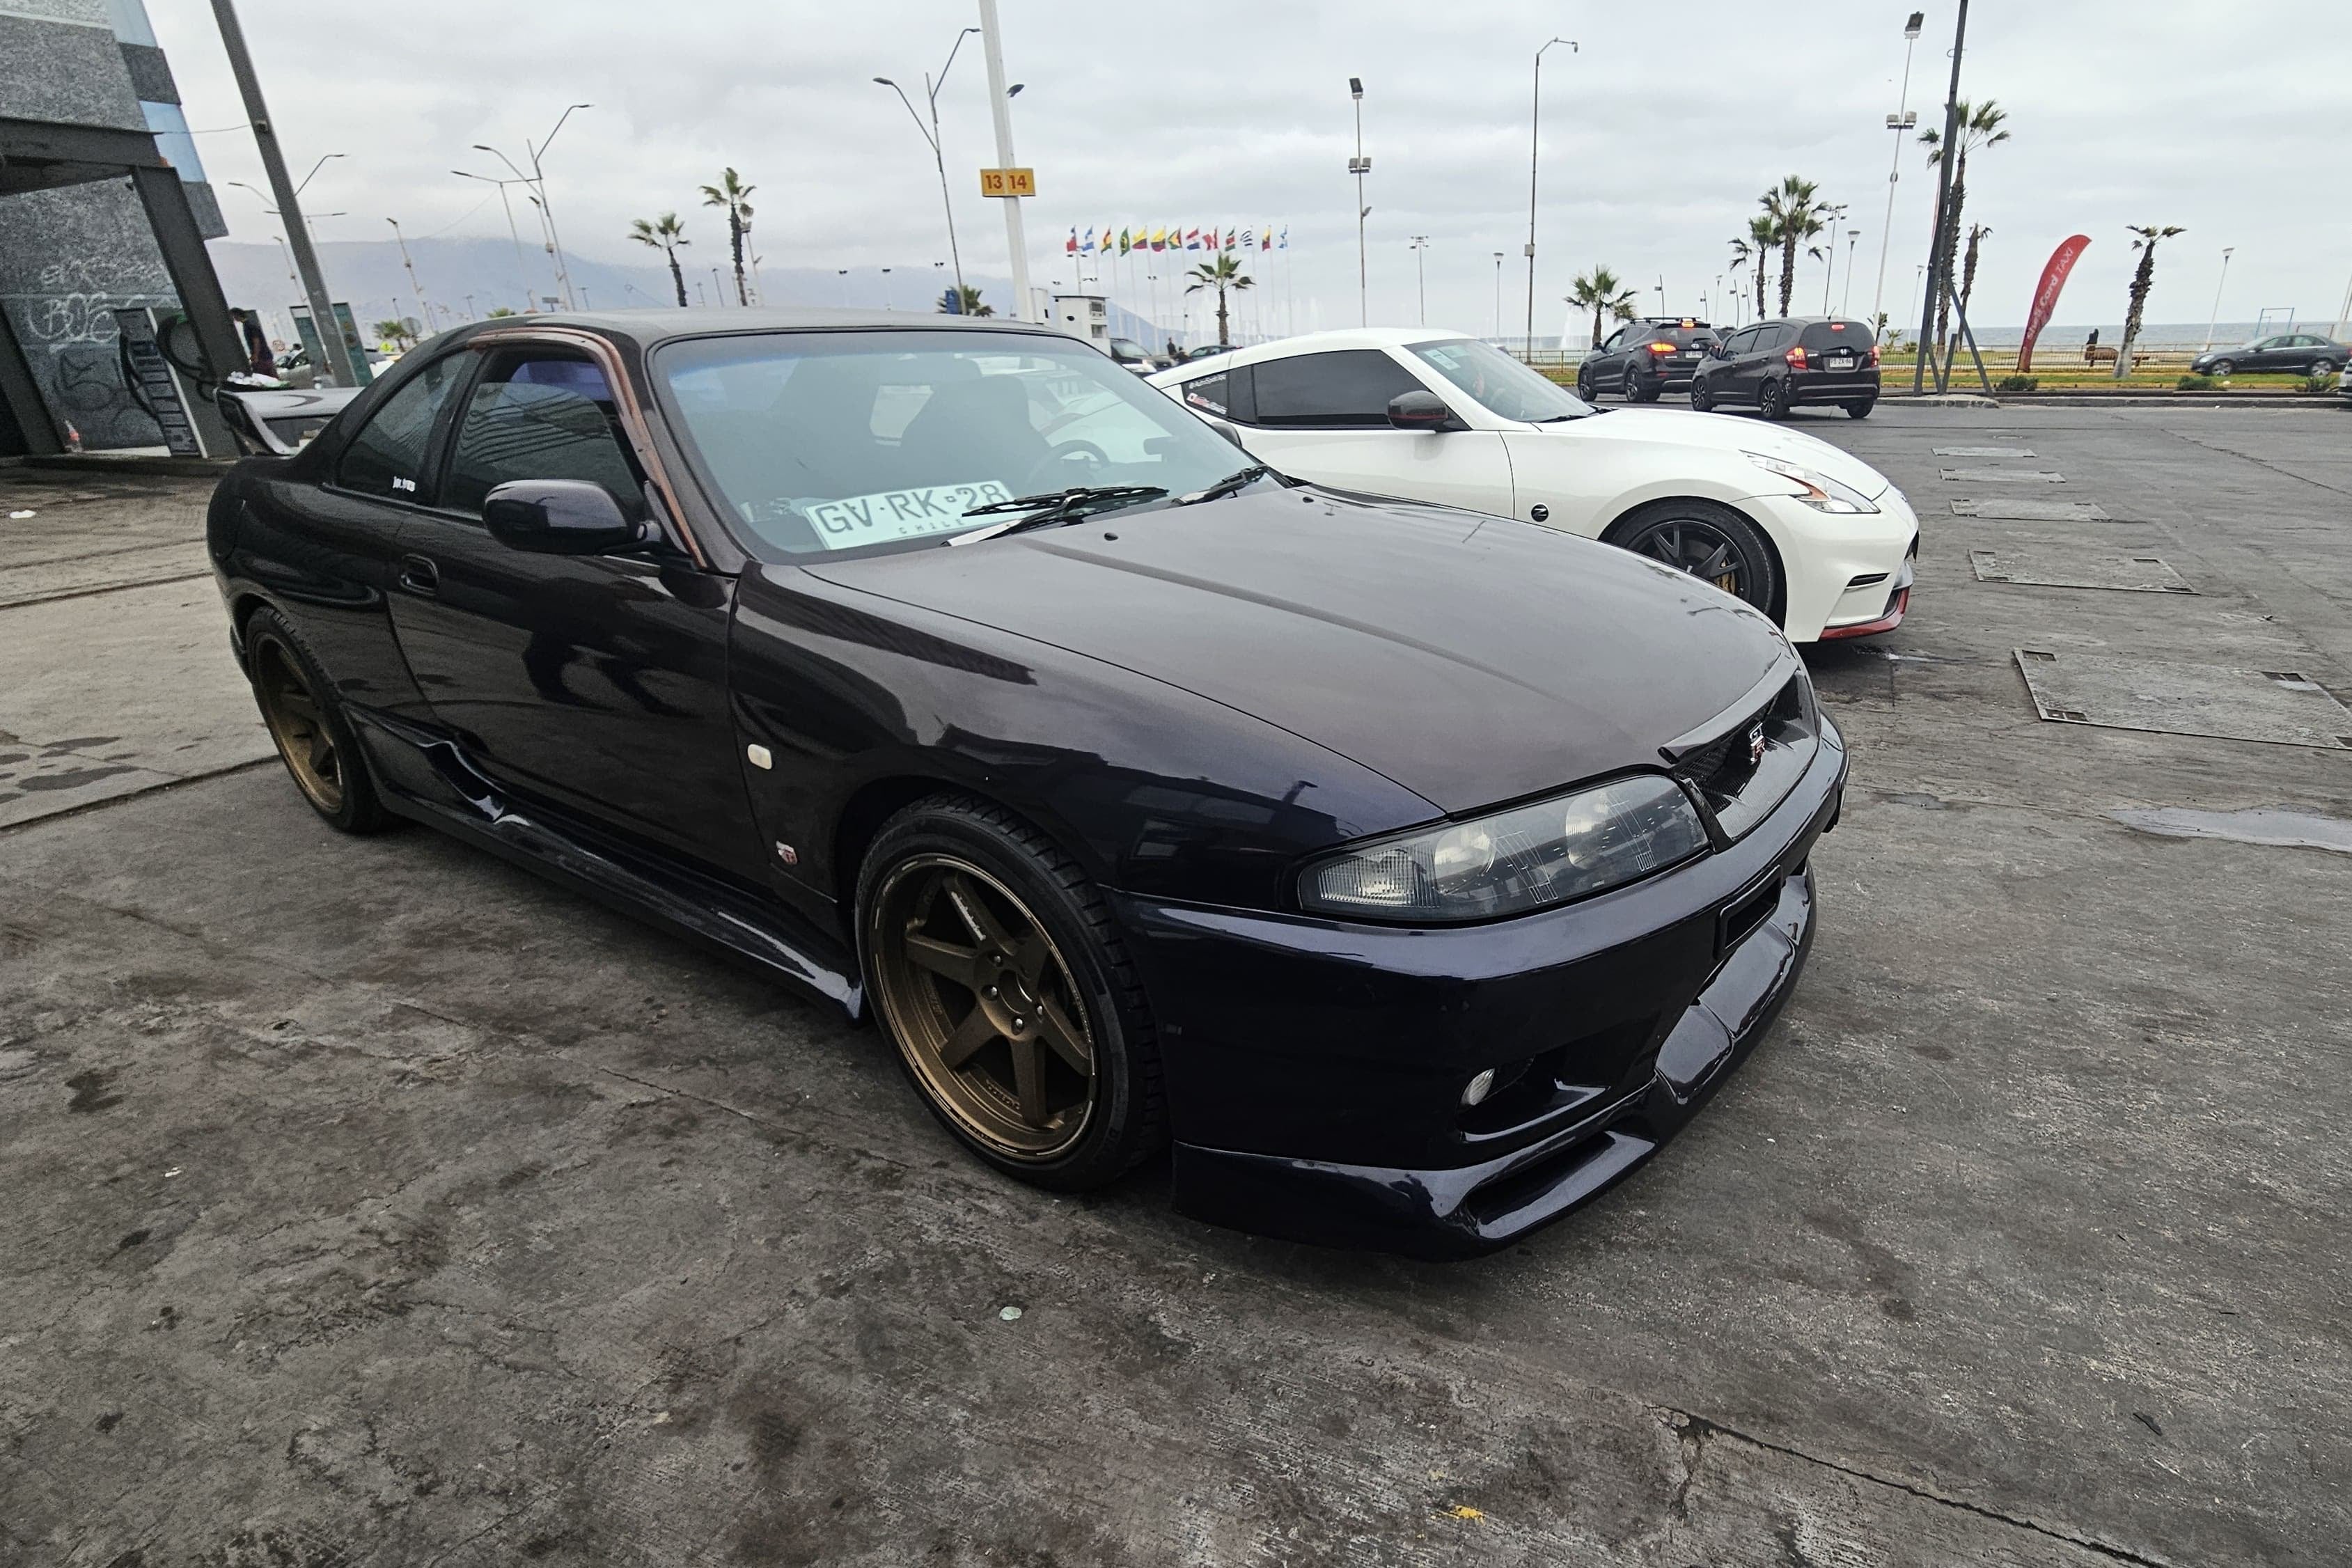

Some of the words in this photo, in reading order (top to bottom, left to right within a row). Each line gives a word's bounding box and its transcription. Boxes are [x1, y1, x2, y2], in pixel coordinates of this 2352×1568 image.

[985, 175, 1003, 189] 13
[1009, 175, 1027, 189] 14
[2055, 246, 2073, 274] TAXI
[898, 518, 964, 535] CHILE
